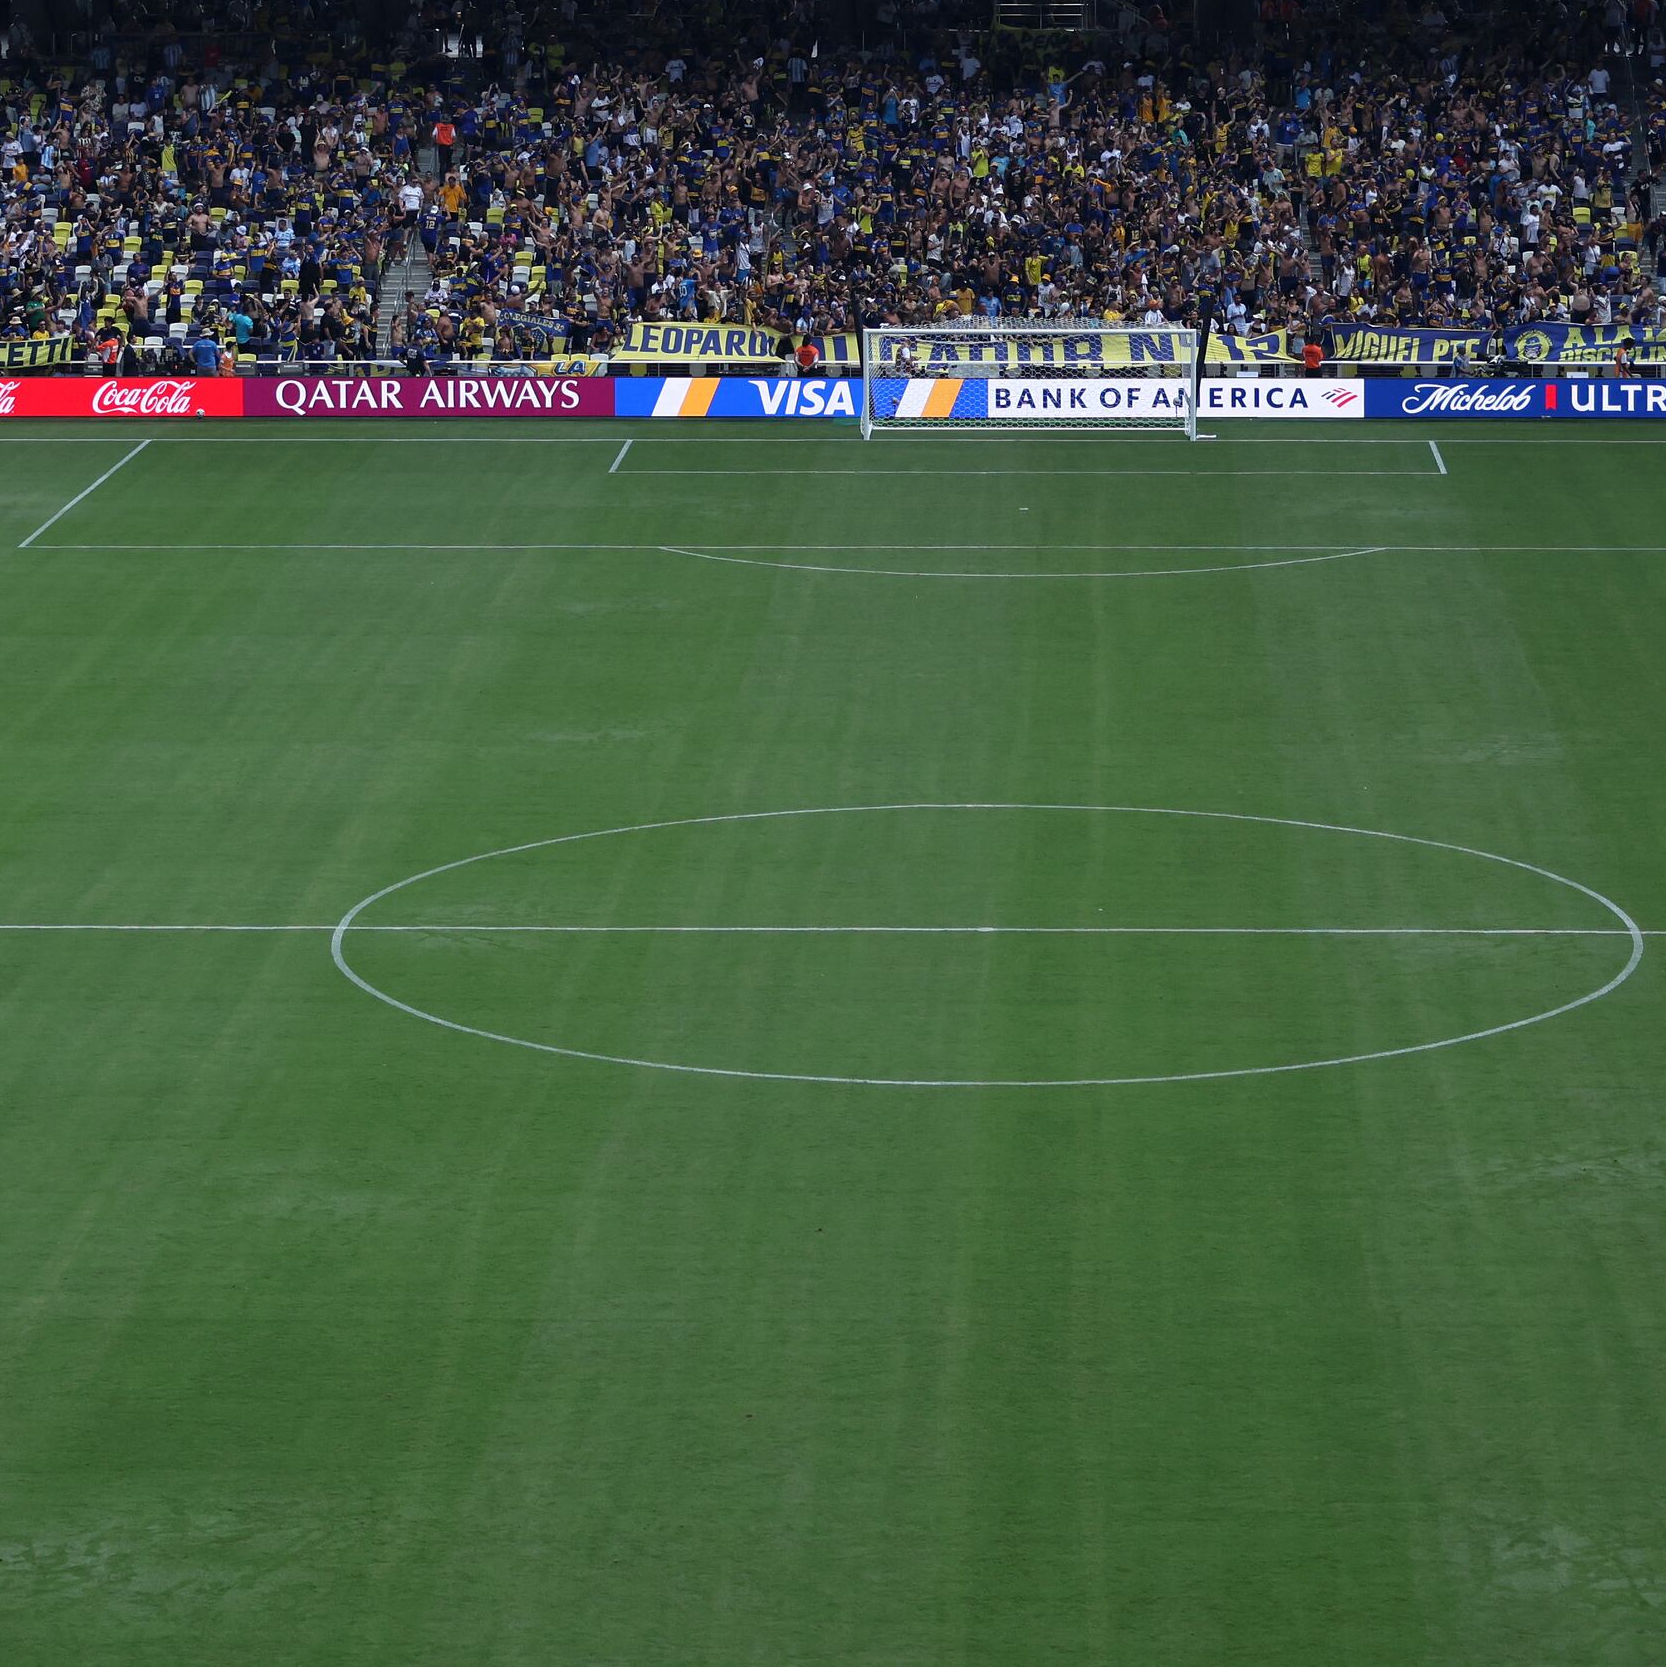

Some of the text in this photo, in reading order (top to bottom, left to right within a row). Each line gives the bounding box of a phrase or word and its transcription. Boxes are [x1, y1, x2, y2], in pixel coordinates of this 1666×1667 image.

[1334, 330, 1420, 361] MIGUEL
[1563, 327, 1586, 348] A
[1594, 325, 1635, 345] LA
[556, 362, 587, 375] LA
[91, 380, 190, 415] Coca-Cola
[276, 379, 580, 416] QATAR AIRWAYS
[748, 380, 855, 416] VISA
[995, 387, 1309, 408] BANK OF AMERICA
[1401, 383, 1537, 415] Michelob
